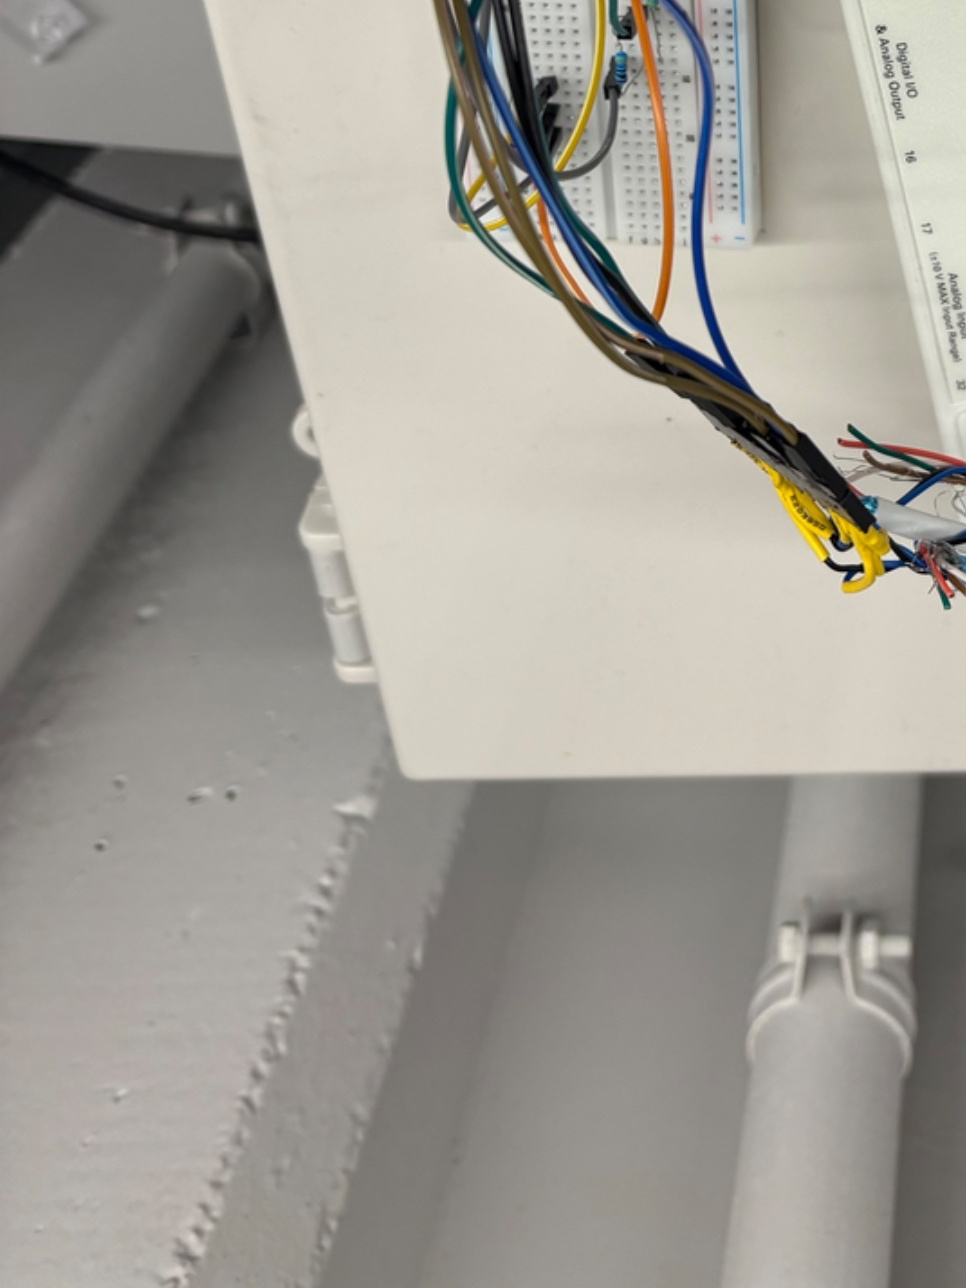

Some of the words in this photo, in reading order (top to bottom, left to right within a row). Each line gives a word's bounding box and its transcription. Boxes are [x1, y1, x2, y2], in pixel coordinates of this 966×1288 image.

[874, 24, 888, 35] &
[879, 38, 895, 79] Analog
[896, 42, 913, 79] Digital
[905, 81, 919, 99] I/O
[889, 80, 906, 121] Output
[904, 150, 917, 164] 16
[921, 222, 933, 234] 17
[937, 282, 949, 305] MAX
[948, 273, 962, 310] Analog
[942, 306, 953, 330] Input
[948, 330, 962, 363] Range)
